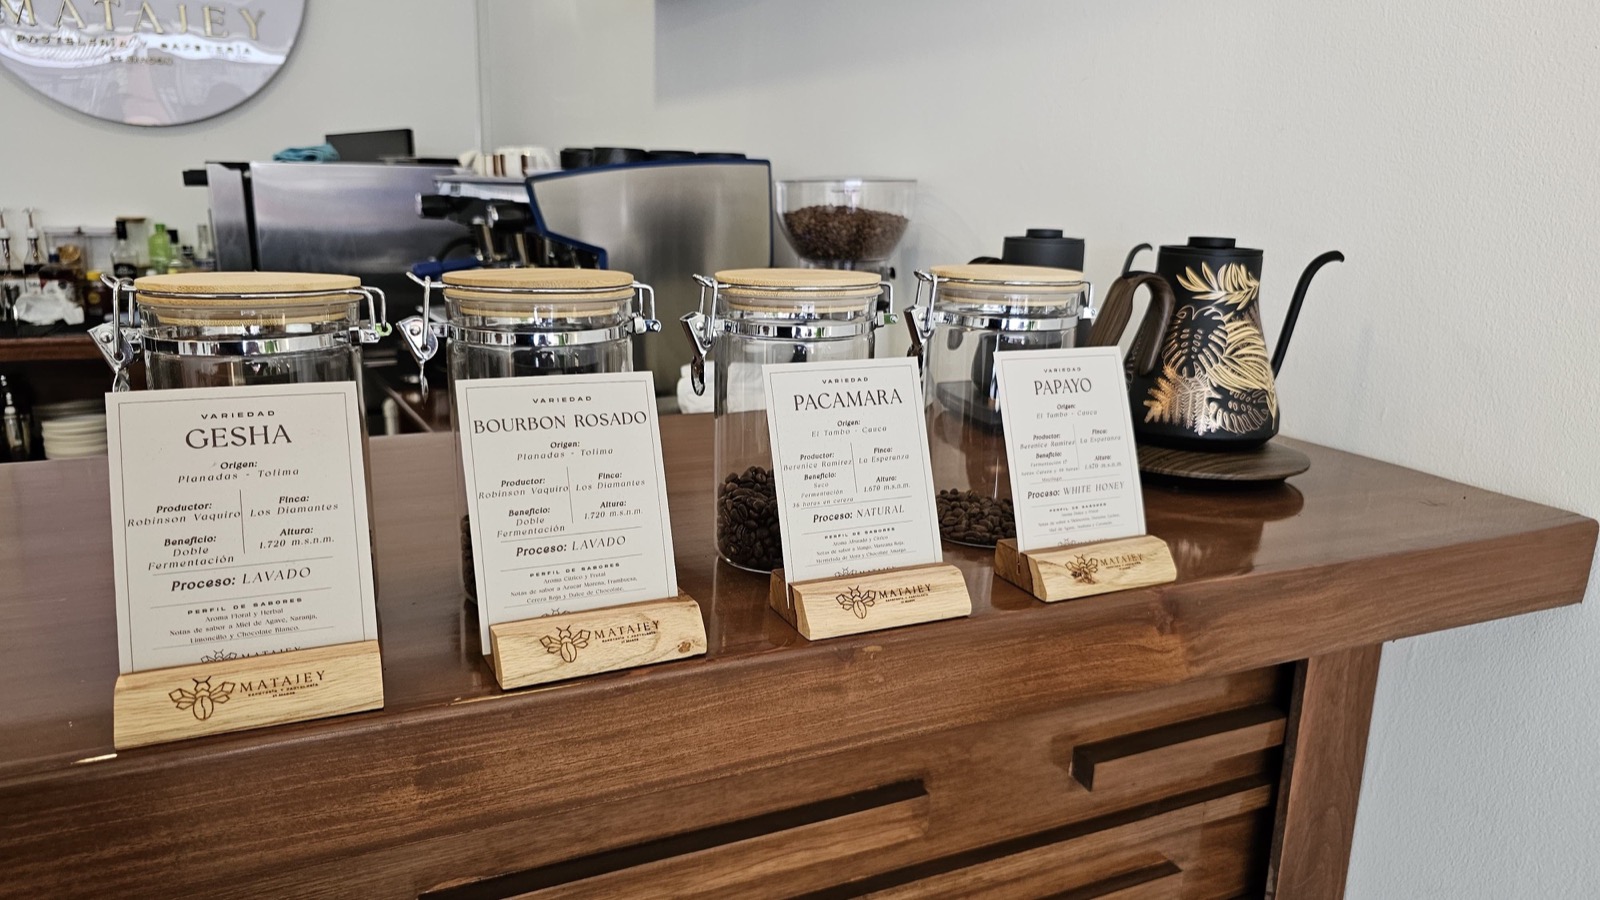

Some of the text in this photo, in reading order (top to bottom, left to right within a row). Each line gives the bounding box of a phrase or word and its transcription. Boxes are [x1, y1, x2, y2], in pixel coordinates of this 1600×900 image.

[822, 376, 869, 384] VARIEDAD
[1034, 377, 1092, 396] PAPAYO
[533, 395, 592, 404] VARIEDAD
[793, 388, 903, 411] PACAMARA
[201, 410, 276, 420] VARIEDAD
[474, 410, 647, 435] BOURBON ROSADO
[837, 419, 861, 428] Origen:
[185, 424, 293, 450] GESHA
[811, 430, 820, 438] El
[824, 428, 850, 436] Tambo
[861, 425, 887, 434] Cauca
[550, 440, 580, 450] Origen:
[873, 446, 893, 454] Finca:
[517, 451, 565, 461] Planadas
[580, 447, 614, 457] Tolima
[800, 452, 835, 461] Productor:
[859, 453, 910, 464] La Esperanza
[220, 460, 258, 471] Origen:
[783, 462, 818, 472] Berenice
[178, 472, 238, 484] Planadas
[258, 468, 300, 479] Tolima
[598, 471, 623, 480] Finca:
[804, 472, 837, 481] Beneficio:
[876, 475, 897, 484] Altura:
[501, 477, 546, 488] Productor:
[575, 478, 646, 492] Los Diamantes
[478, 485, 569, 500] Robinson Vaquiro
[1027, 481, 1125, 500] Proceso: WHITE HONEY
[279, 494, 310, 505] Finca:
[600, 500, 627, 510] Altura:
[156, 502, 212, 514] Productor:
[250, 502, 339, 518] Los Diamantes
[508, 506, 551, 518] Beneficio:
[813, 504, 904, 524] Proceso: NATURAL
[127, 510, 241, 528] Robinson Vaquiro
[516, 516, 545, 527] Doble
[584, 511, 606, 520] 1.720
[280, 526, 314, 537] Altura:
[497, 524, 565, 538] Fermentación
[164, 535, 217, 548] Beneficio:
[259, 535, 335, 550] 1.720 m.s.n.m.
[516, 535, 627, 558] Proceso: LAVADO
[172, 545, 209, 558] Doble
[148, 554, 235, 571] Fermentación
[529, 570, 560, 578] PERFIL
[581, 562, 620, 571] SABORES
[171, 566, 311, 592] Proceso: LAVADO
[187, 606, 227, 615] PERFIL
[253, 597, 303, 608] SABORES
[205, 615, 229, 623] Aroma
[231, 611, 251, 620] Floral
[260, 608, 284, 616] Herbal
[169, 629, 191, 637] Notas
[205, 624, 226, 633] sabor
[237, 628, 273, 639] Chocolate
